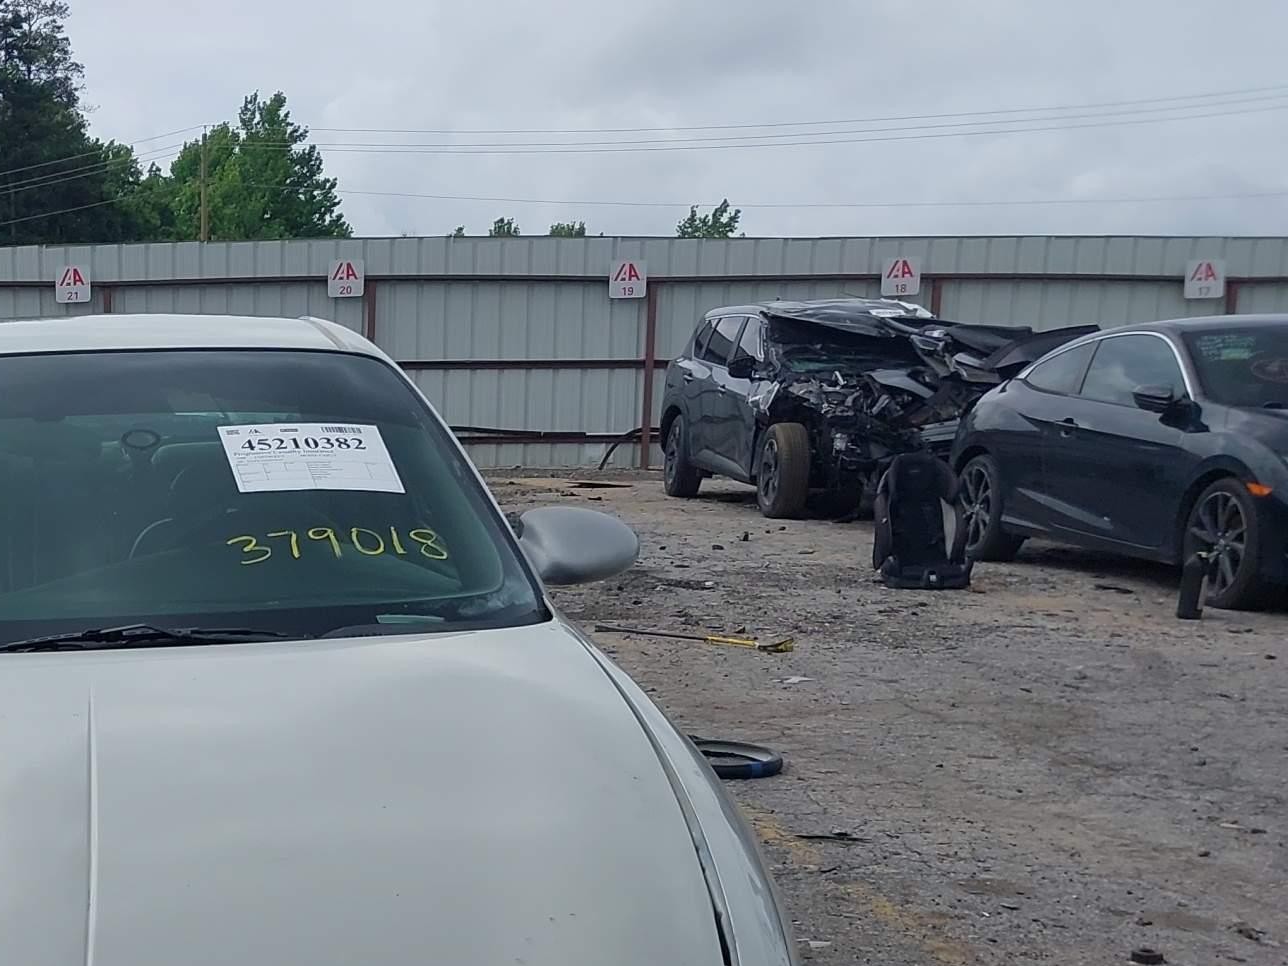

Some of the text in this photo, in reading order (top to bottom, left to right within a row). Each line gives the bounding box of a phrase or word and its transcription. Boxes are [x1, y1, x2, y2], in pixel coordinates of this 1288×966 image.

[339, 285, 352, 295] 20
[621, 286, 634, 296] 19
[895, 283, 907, 293] 18
[67, 291, 79, 301] 21
[240, 436, 367, 451] 45210382
[226, 526, 448, 565] 379018
